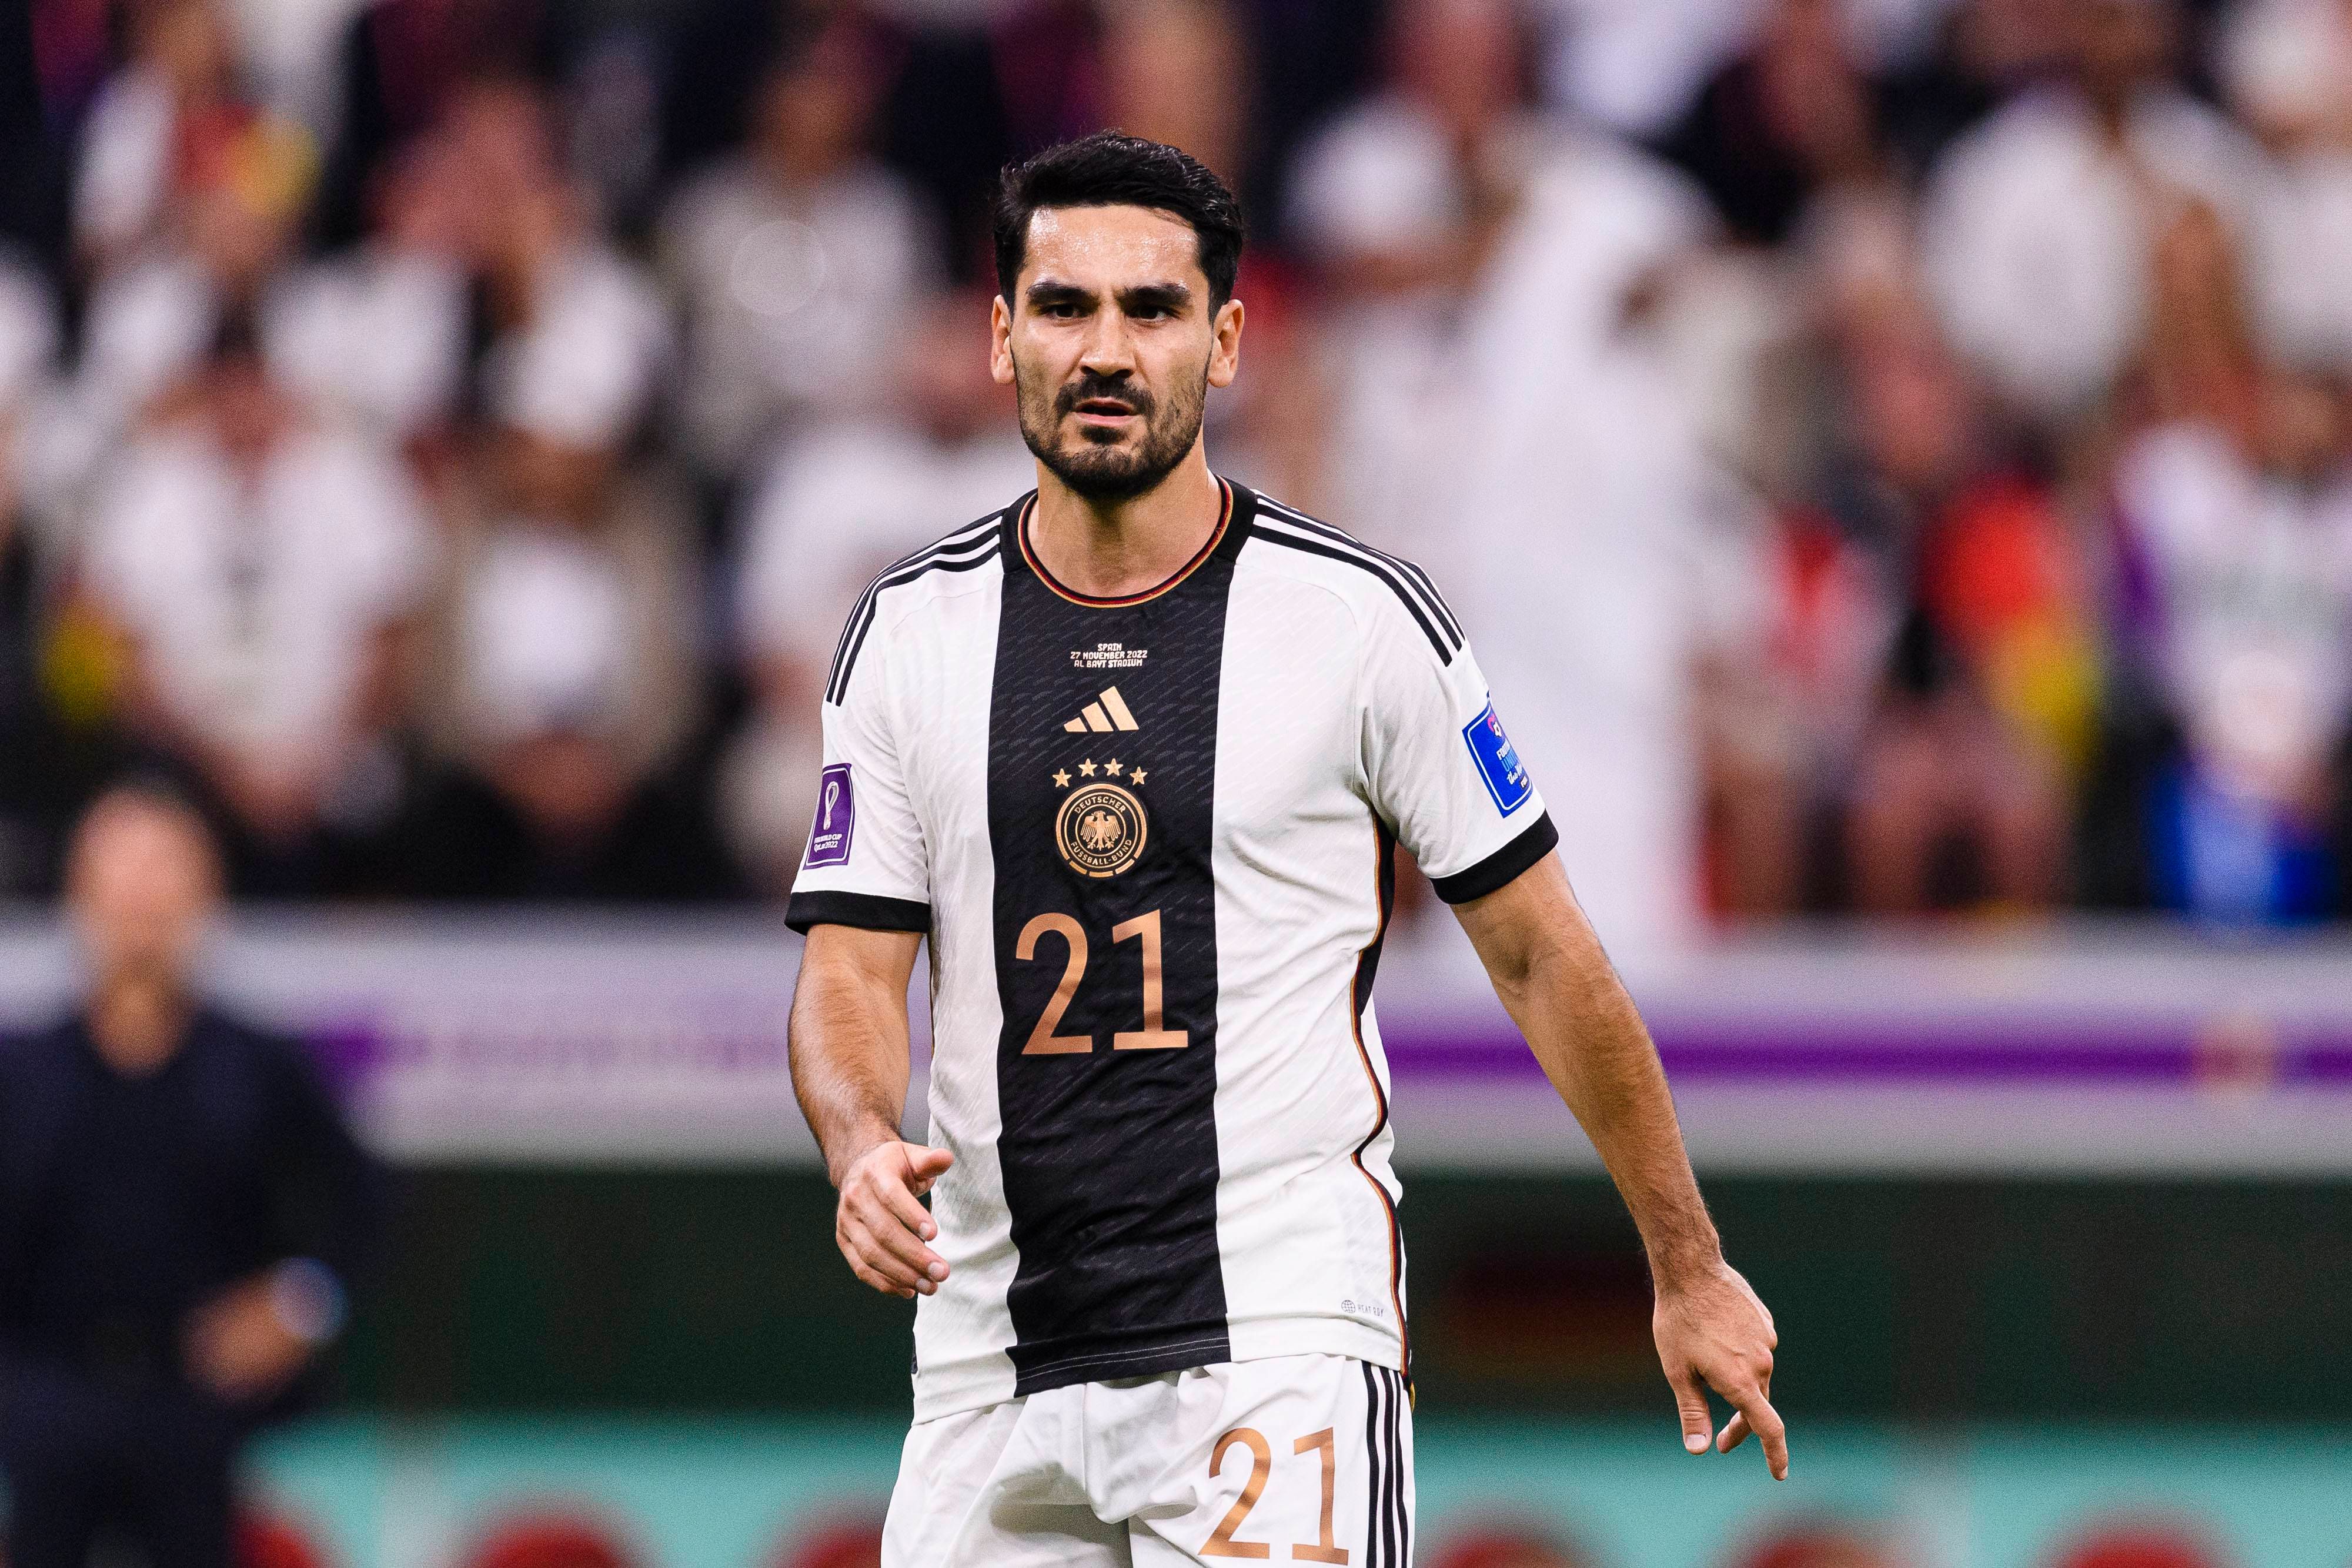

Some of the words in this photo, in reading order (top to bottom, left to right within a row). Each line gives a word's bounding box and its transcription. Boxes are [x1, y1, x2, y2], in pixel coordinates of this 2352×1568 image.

[1083, 651, 1125, 660] NOVEMBER
[1127, 650, 1148, 658] 2022
[1097, 643, 1122, 651] SPAIN
[1087, 660, 1107, 668] BAYT
[1108, 659, 1142, 668] STADIUM
[1074, 796, 1126, 814] DEUTSCHER
[1071, 839, 1132, 865] FUSSBALL-BUND
[1015, 909, 1188, 1055] 21
[1198, 1426, 1349, 1566] 21
